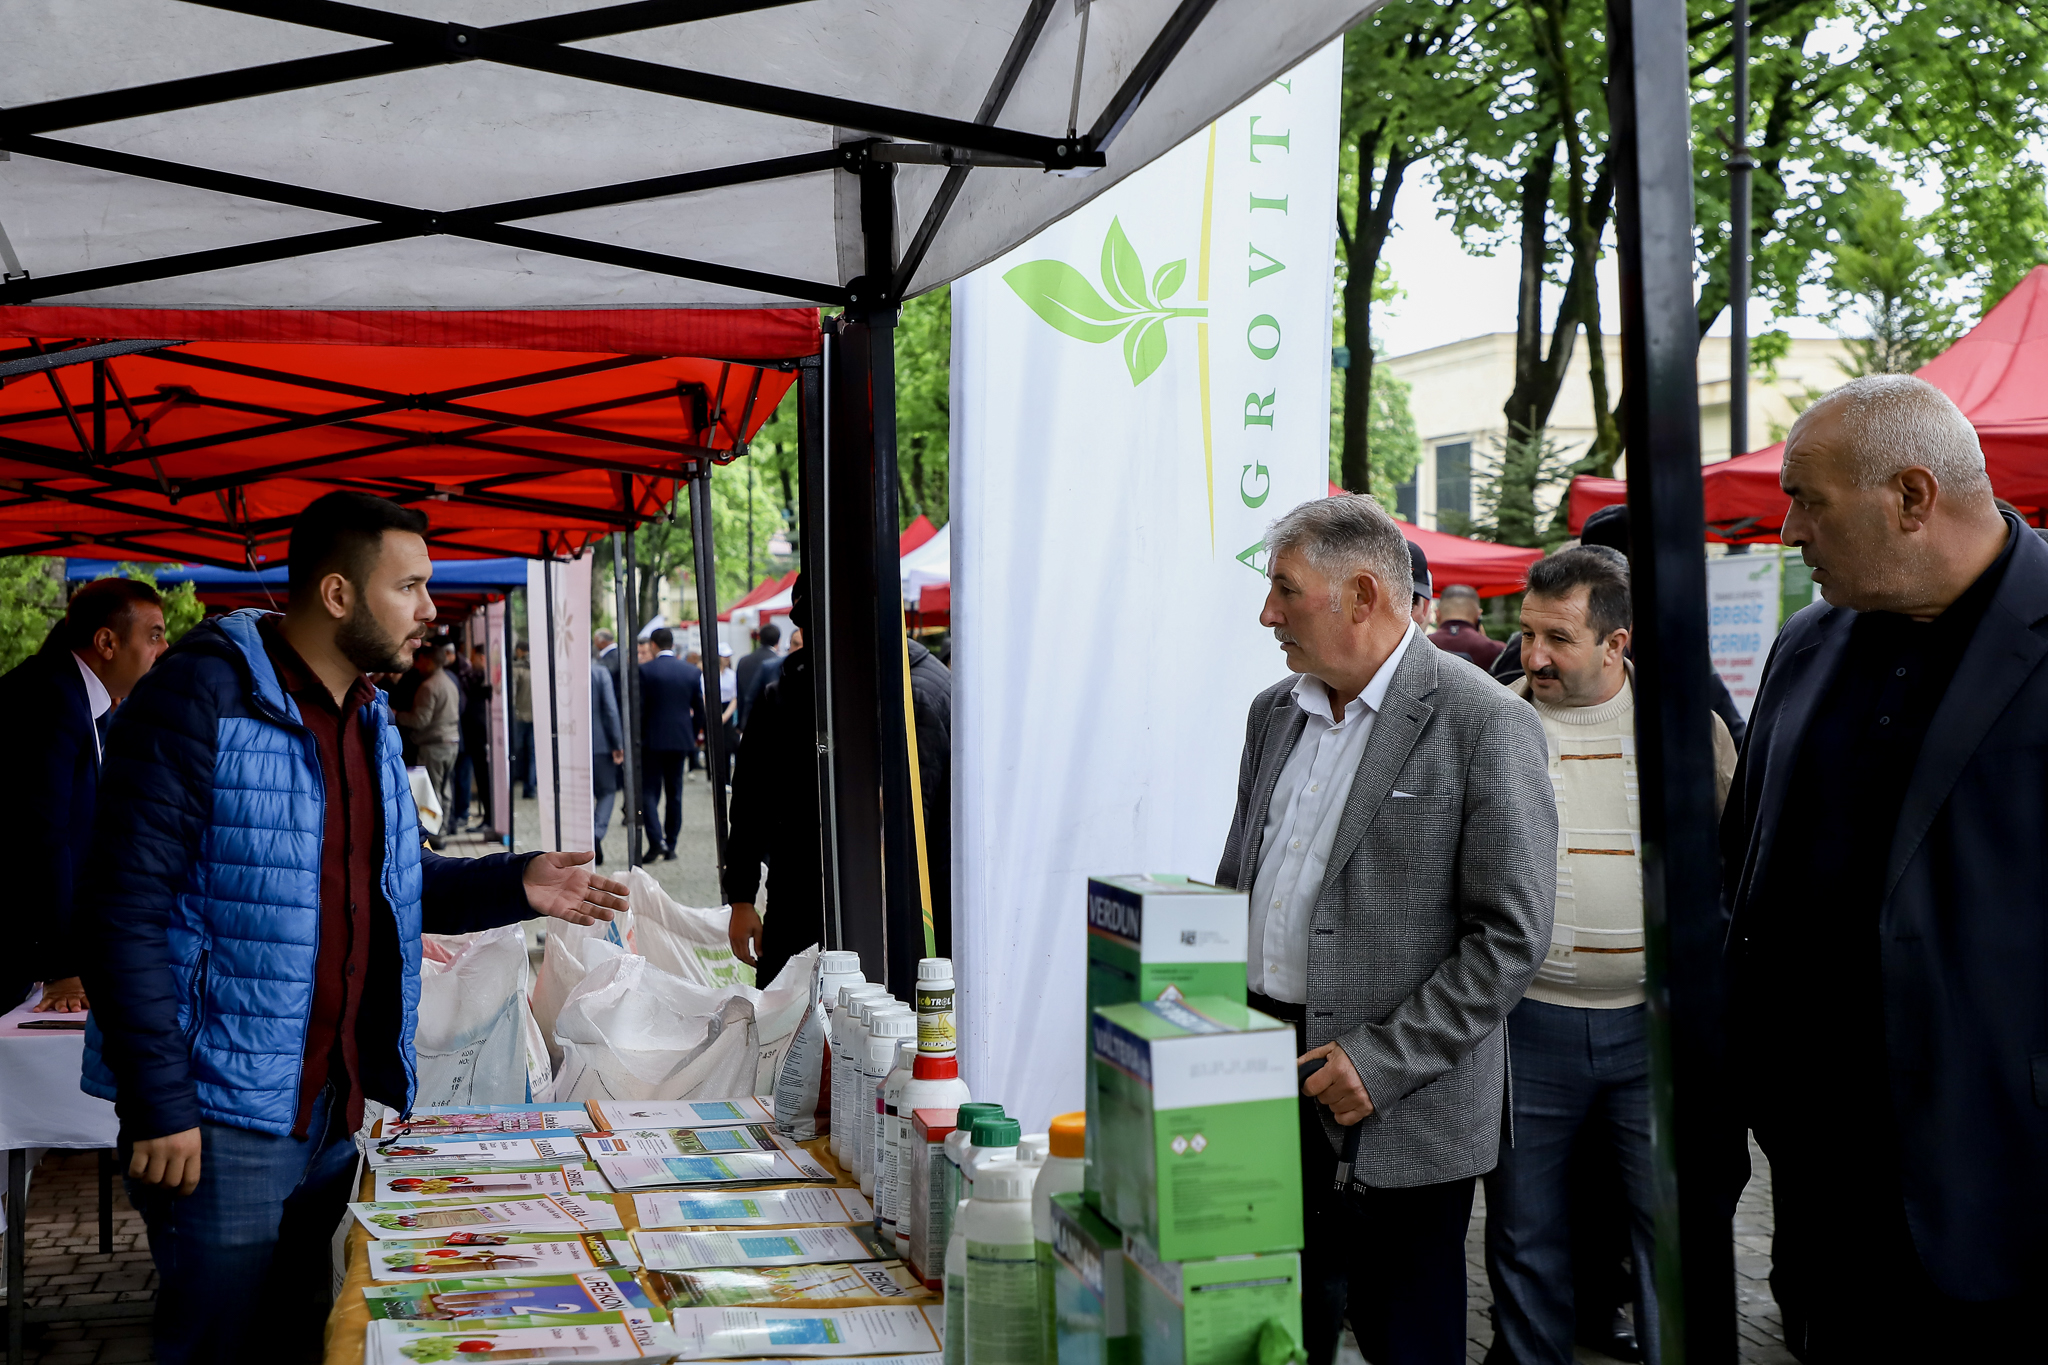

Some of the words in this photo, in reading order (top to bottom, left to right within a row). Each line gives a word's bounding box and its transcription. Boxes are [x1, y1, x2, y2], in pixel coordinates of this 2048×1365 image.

[1089, 894, 1140, 939] VERDUN
[554, 1196, 590, 1218] VALTERA
[587, 1280, 627, 1311] REIKON
[864, 1269, 906, 1297] REIKON
